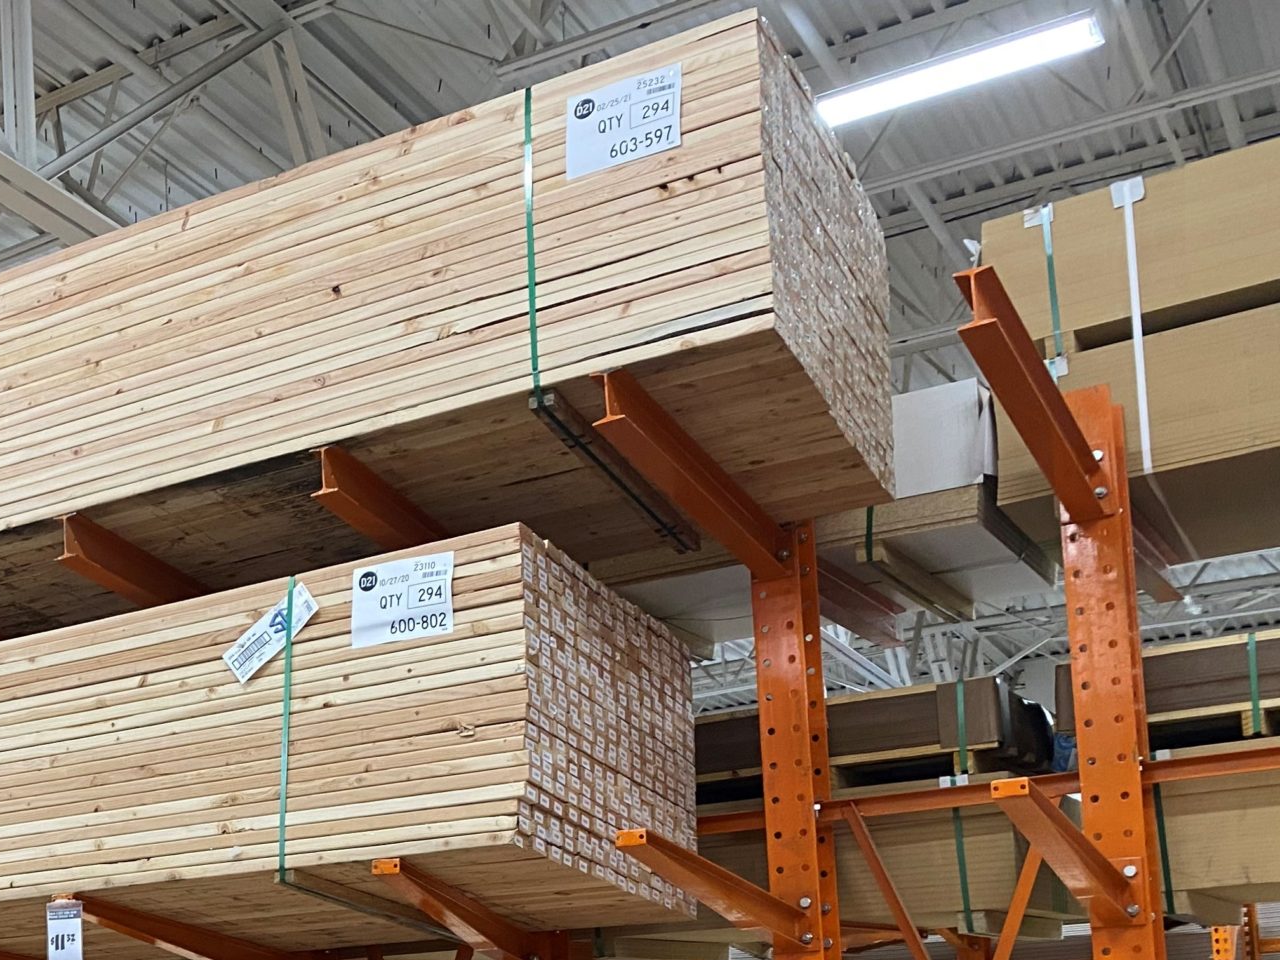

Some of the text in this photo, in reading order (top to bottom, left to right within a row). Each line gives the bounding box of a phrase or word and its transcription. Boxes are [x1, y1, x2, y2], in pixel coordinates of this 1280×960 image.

[598, 99, 670, 134] QTY 294
[609, 124, 673, 159] 603-597
[360, 574, 410, 588] D21 10/27/20
[379, 584, 443, 610] QTY 294
[390, 612, 447, 635] 600-802
